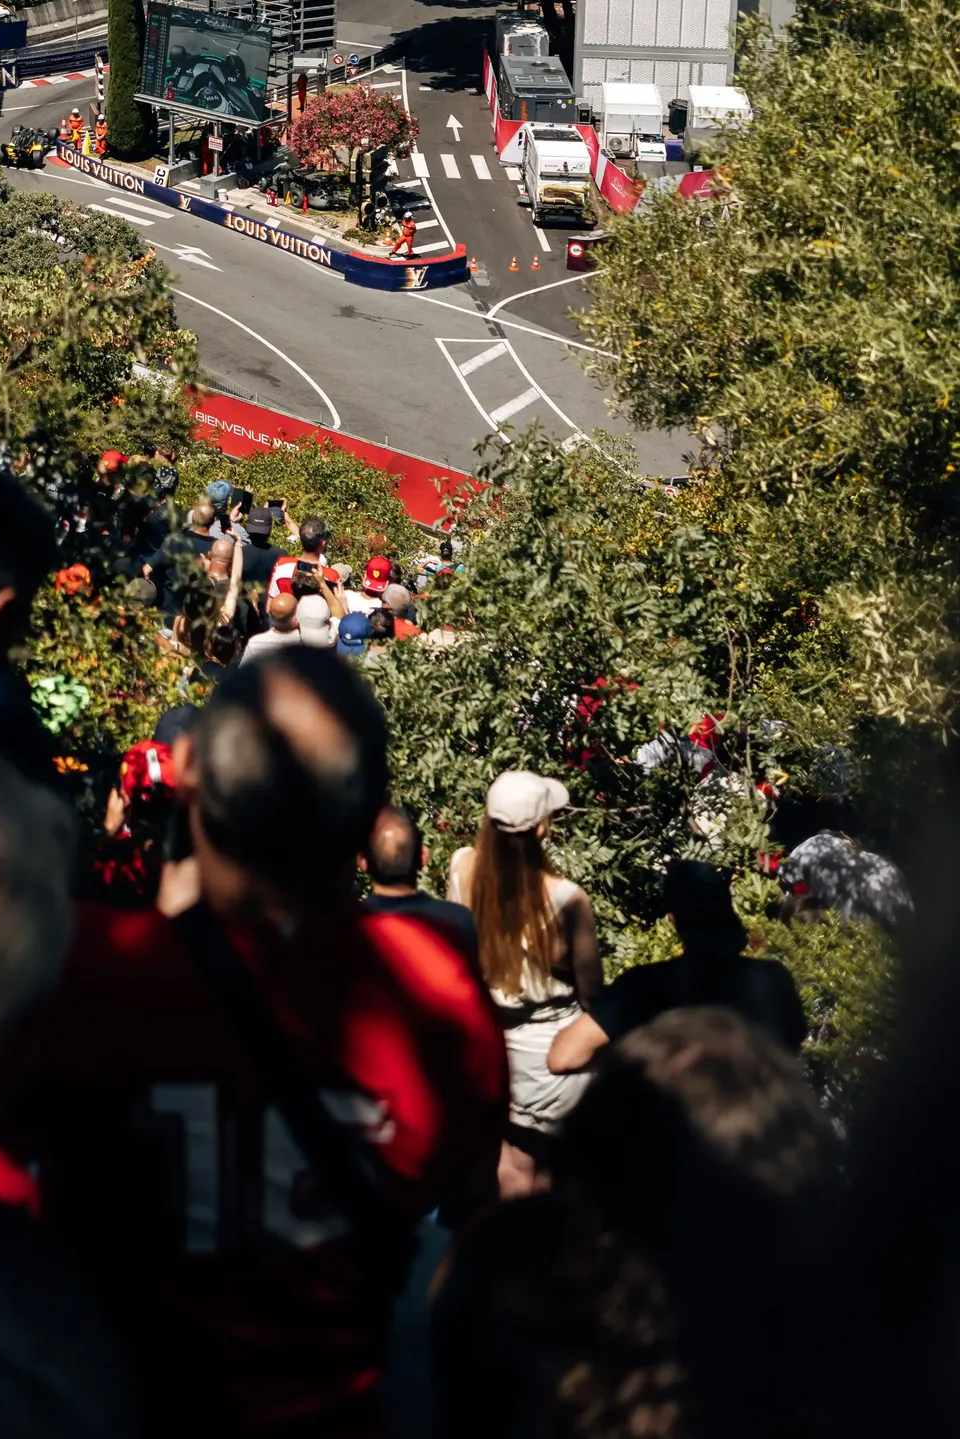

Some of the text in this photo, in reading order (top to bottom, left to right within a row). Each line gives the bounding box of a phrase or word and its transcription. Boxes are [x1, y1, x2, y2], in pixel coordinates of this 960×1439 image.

[60, 146, 145, 195] LOUIS VUITTON
[227, 212, 332, 266] LOUIS VUITTON
[194, 410, 271, 447] BIENVENUE
